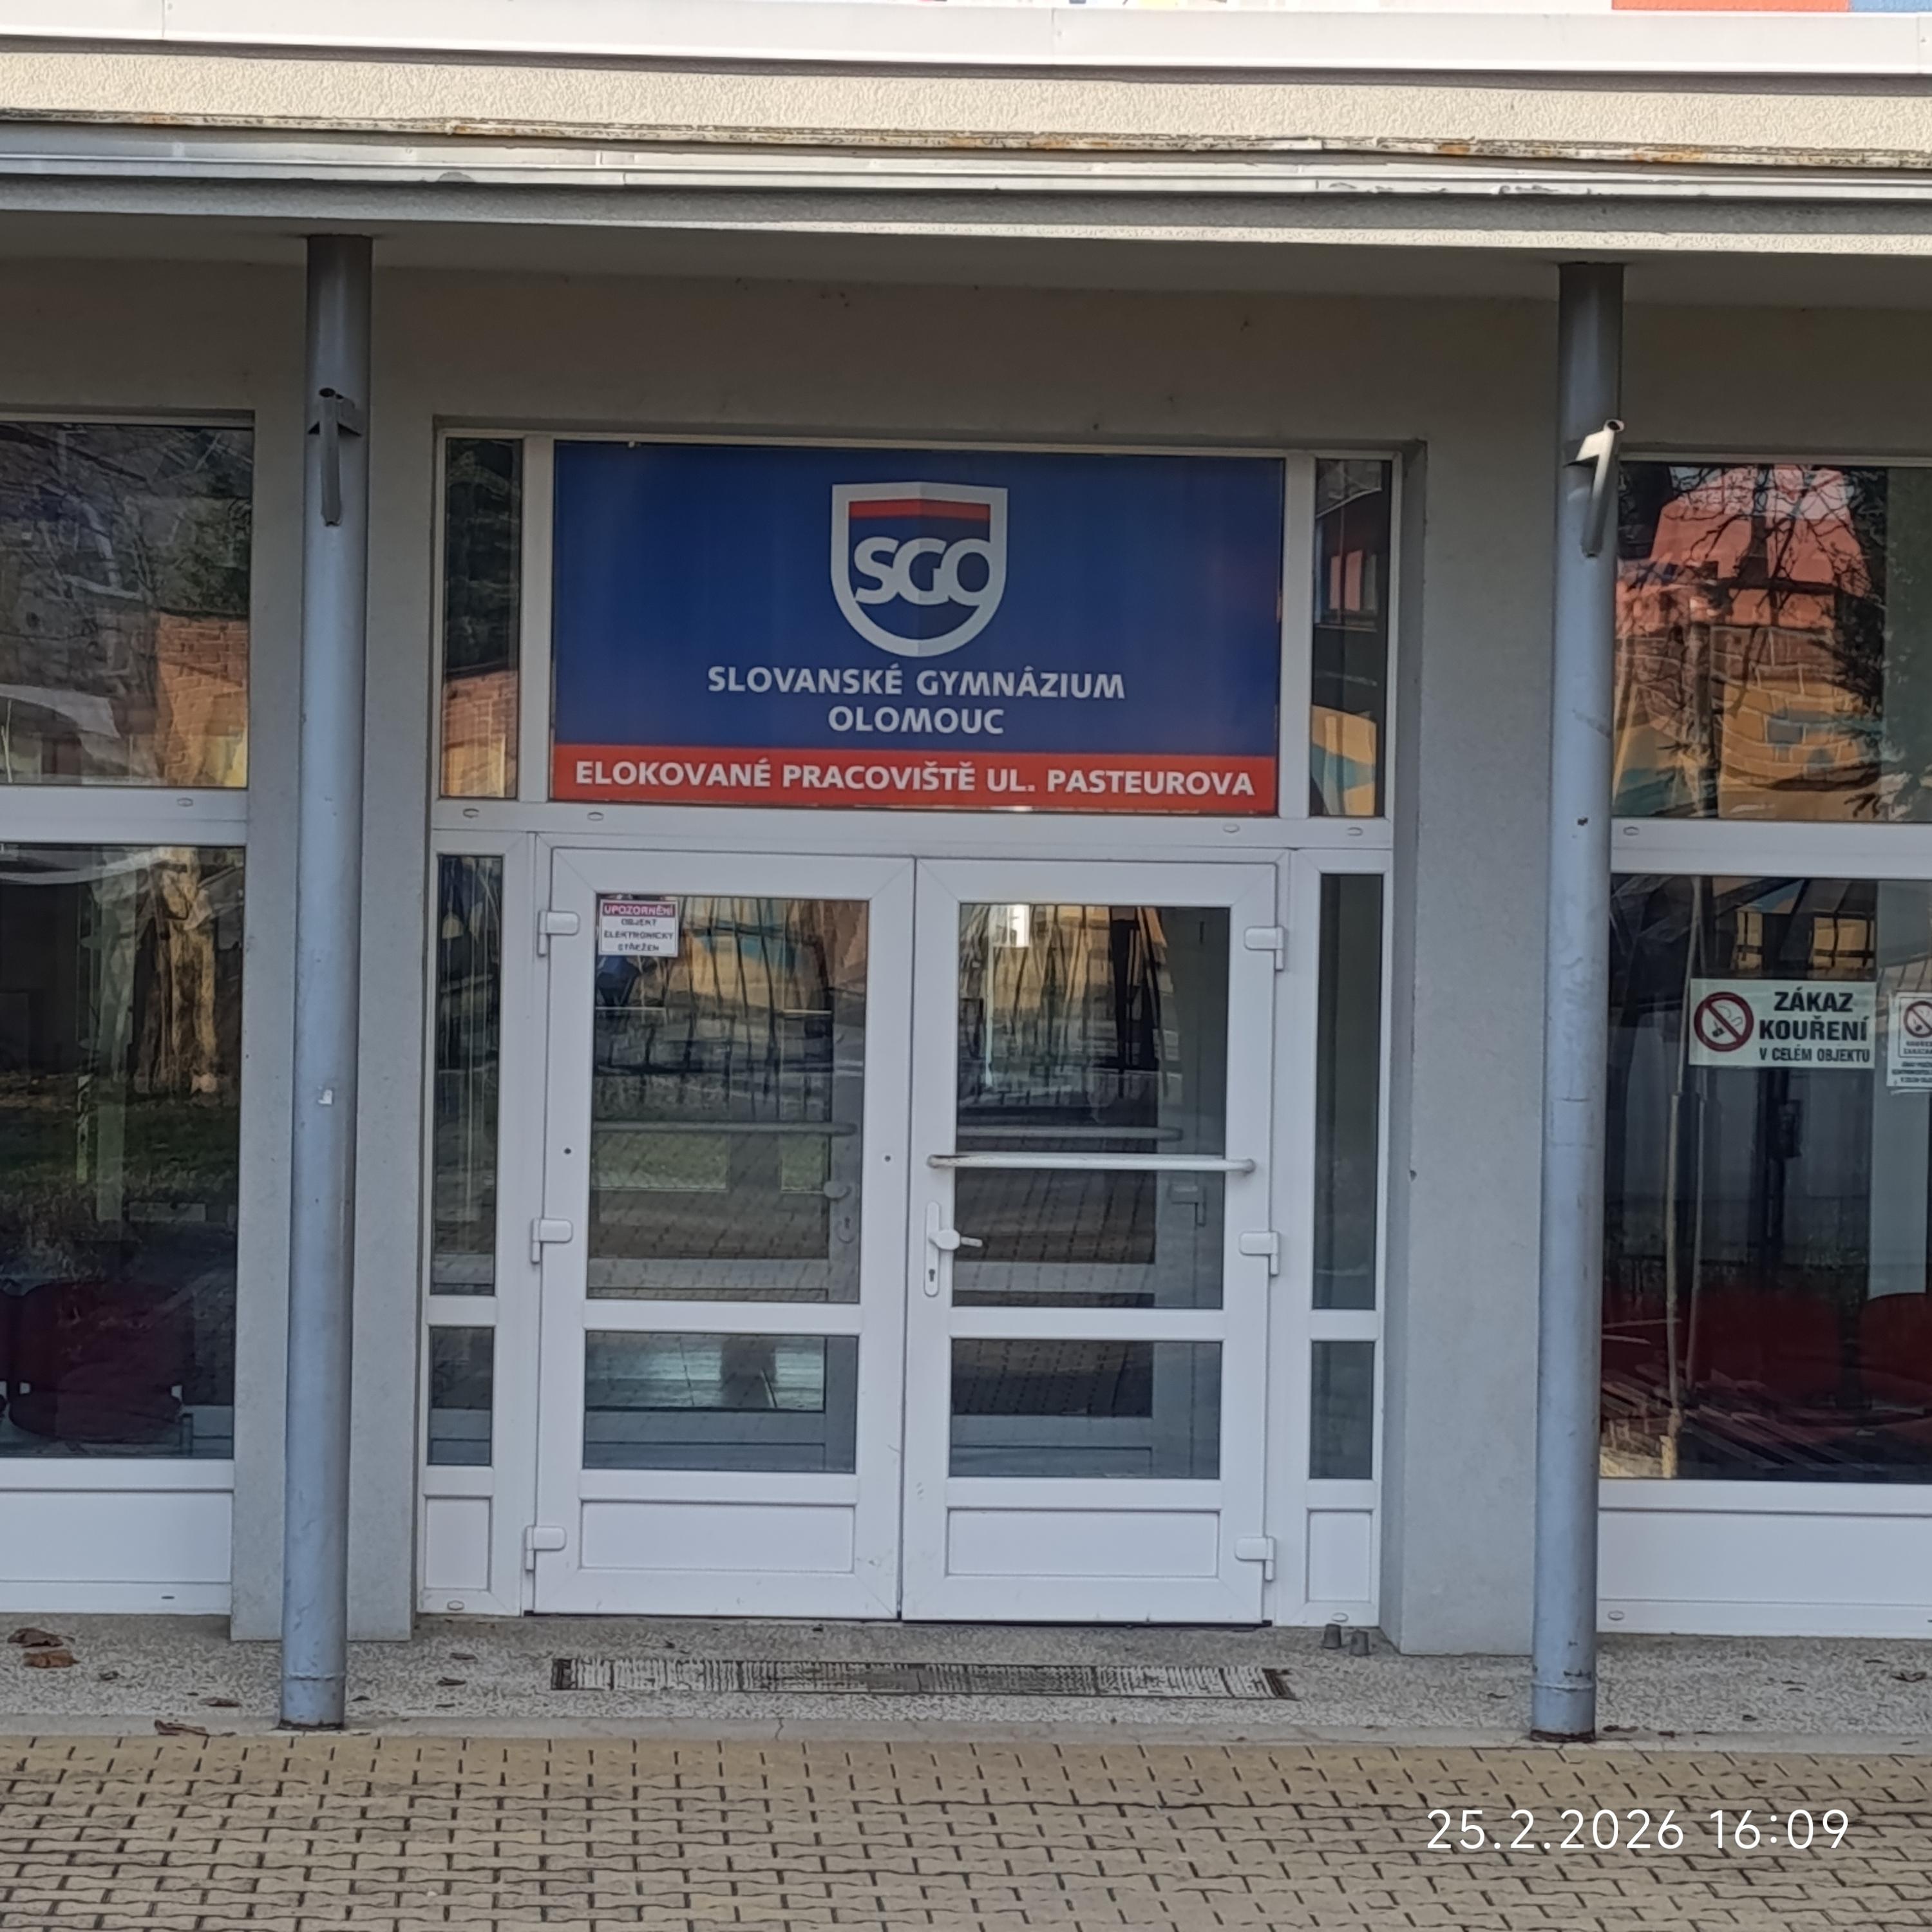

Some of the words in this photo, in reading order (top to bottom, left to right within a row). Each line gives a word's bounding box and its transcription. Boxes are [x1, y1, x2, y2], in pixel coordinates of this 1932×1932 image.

[853, 536, 992, 607] SGO
[708, 663, 902, 696] SLOVANSKÉ
[916, 665, 1125, 699] GYMNÁZIUM
[828, 706, 1004, 735] OLOMOUC
[575, 759, 771, 788] ELOKOVANÉ
[782, 761, 976, 791] PRACOVIŠTĚ
[987, 768, 1035, 793] UL.
[1046, 768, 1255, 797] PASTEUROVA
[604, 904, 673, 916] UPOZORNĚNÍ
[604, 931, 674, 939] ELEKTRONICKY
[618, 942, 659, 951] STŘEŽEN
[1774, 986, 1853, 1012] ZÁKAZ
[1759, 1015, 1870, 1041] KOUŘENÍ
[1759, 1047, 1767, 1061] V
[1772, 1044, 1812, 1061] CELÉM
[1817, 1048, 1870, 1063] OBJEKTU
